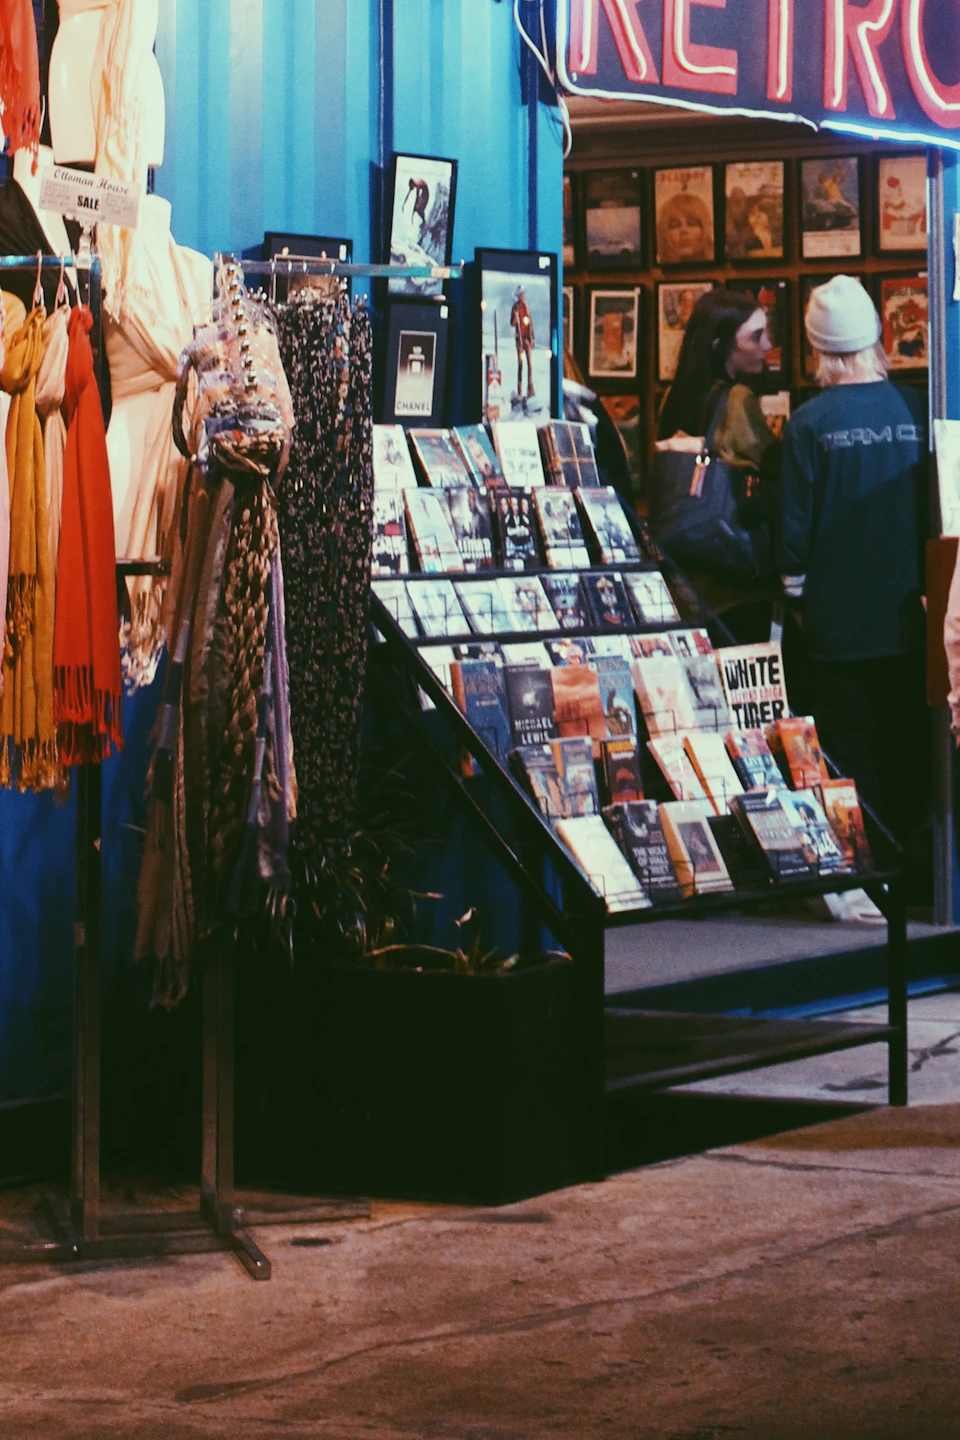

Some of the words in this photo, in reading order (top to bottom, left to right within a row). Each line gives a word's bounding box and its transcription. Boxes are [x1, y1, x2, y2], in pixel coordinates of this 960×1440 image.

[53, 167, 95, 188] Ottoman
[96, 177, 130, 195] House
[77, 194, 100, 211] SALE
[396, 400, 431, 412] CHANEL
[820, 425, 893, 451] TEAM
[514, 716, 554, 732] MICHAEL
